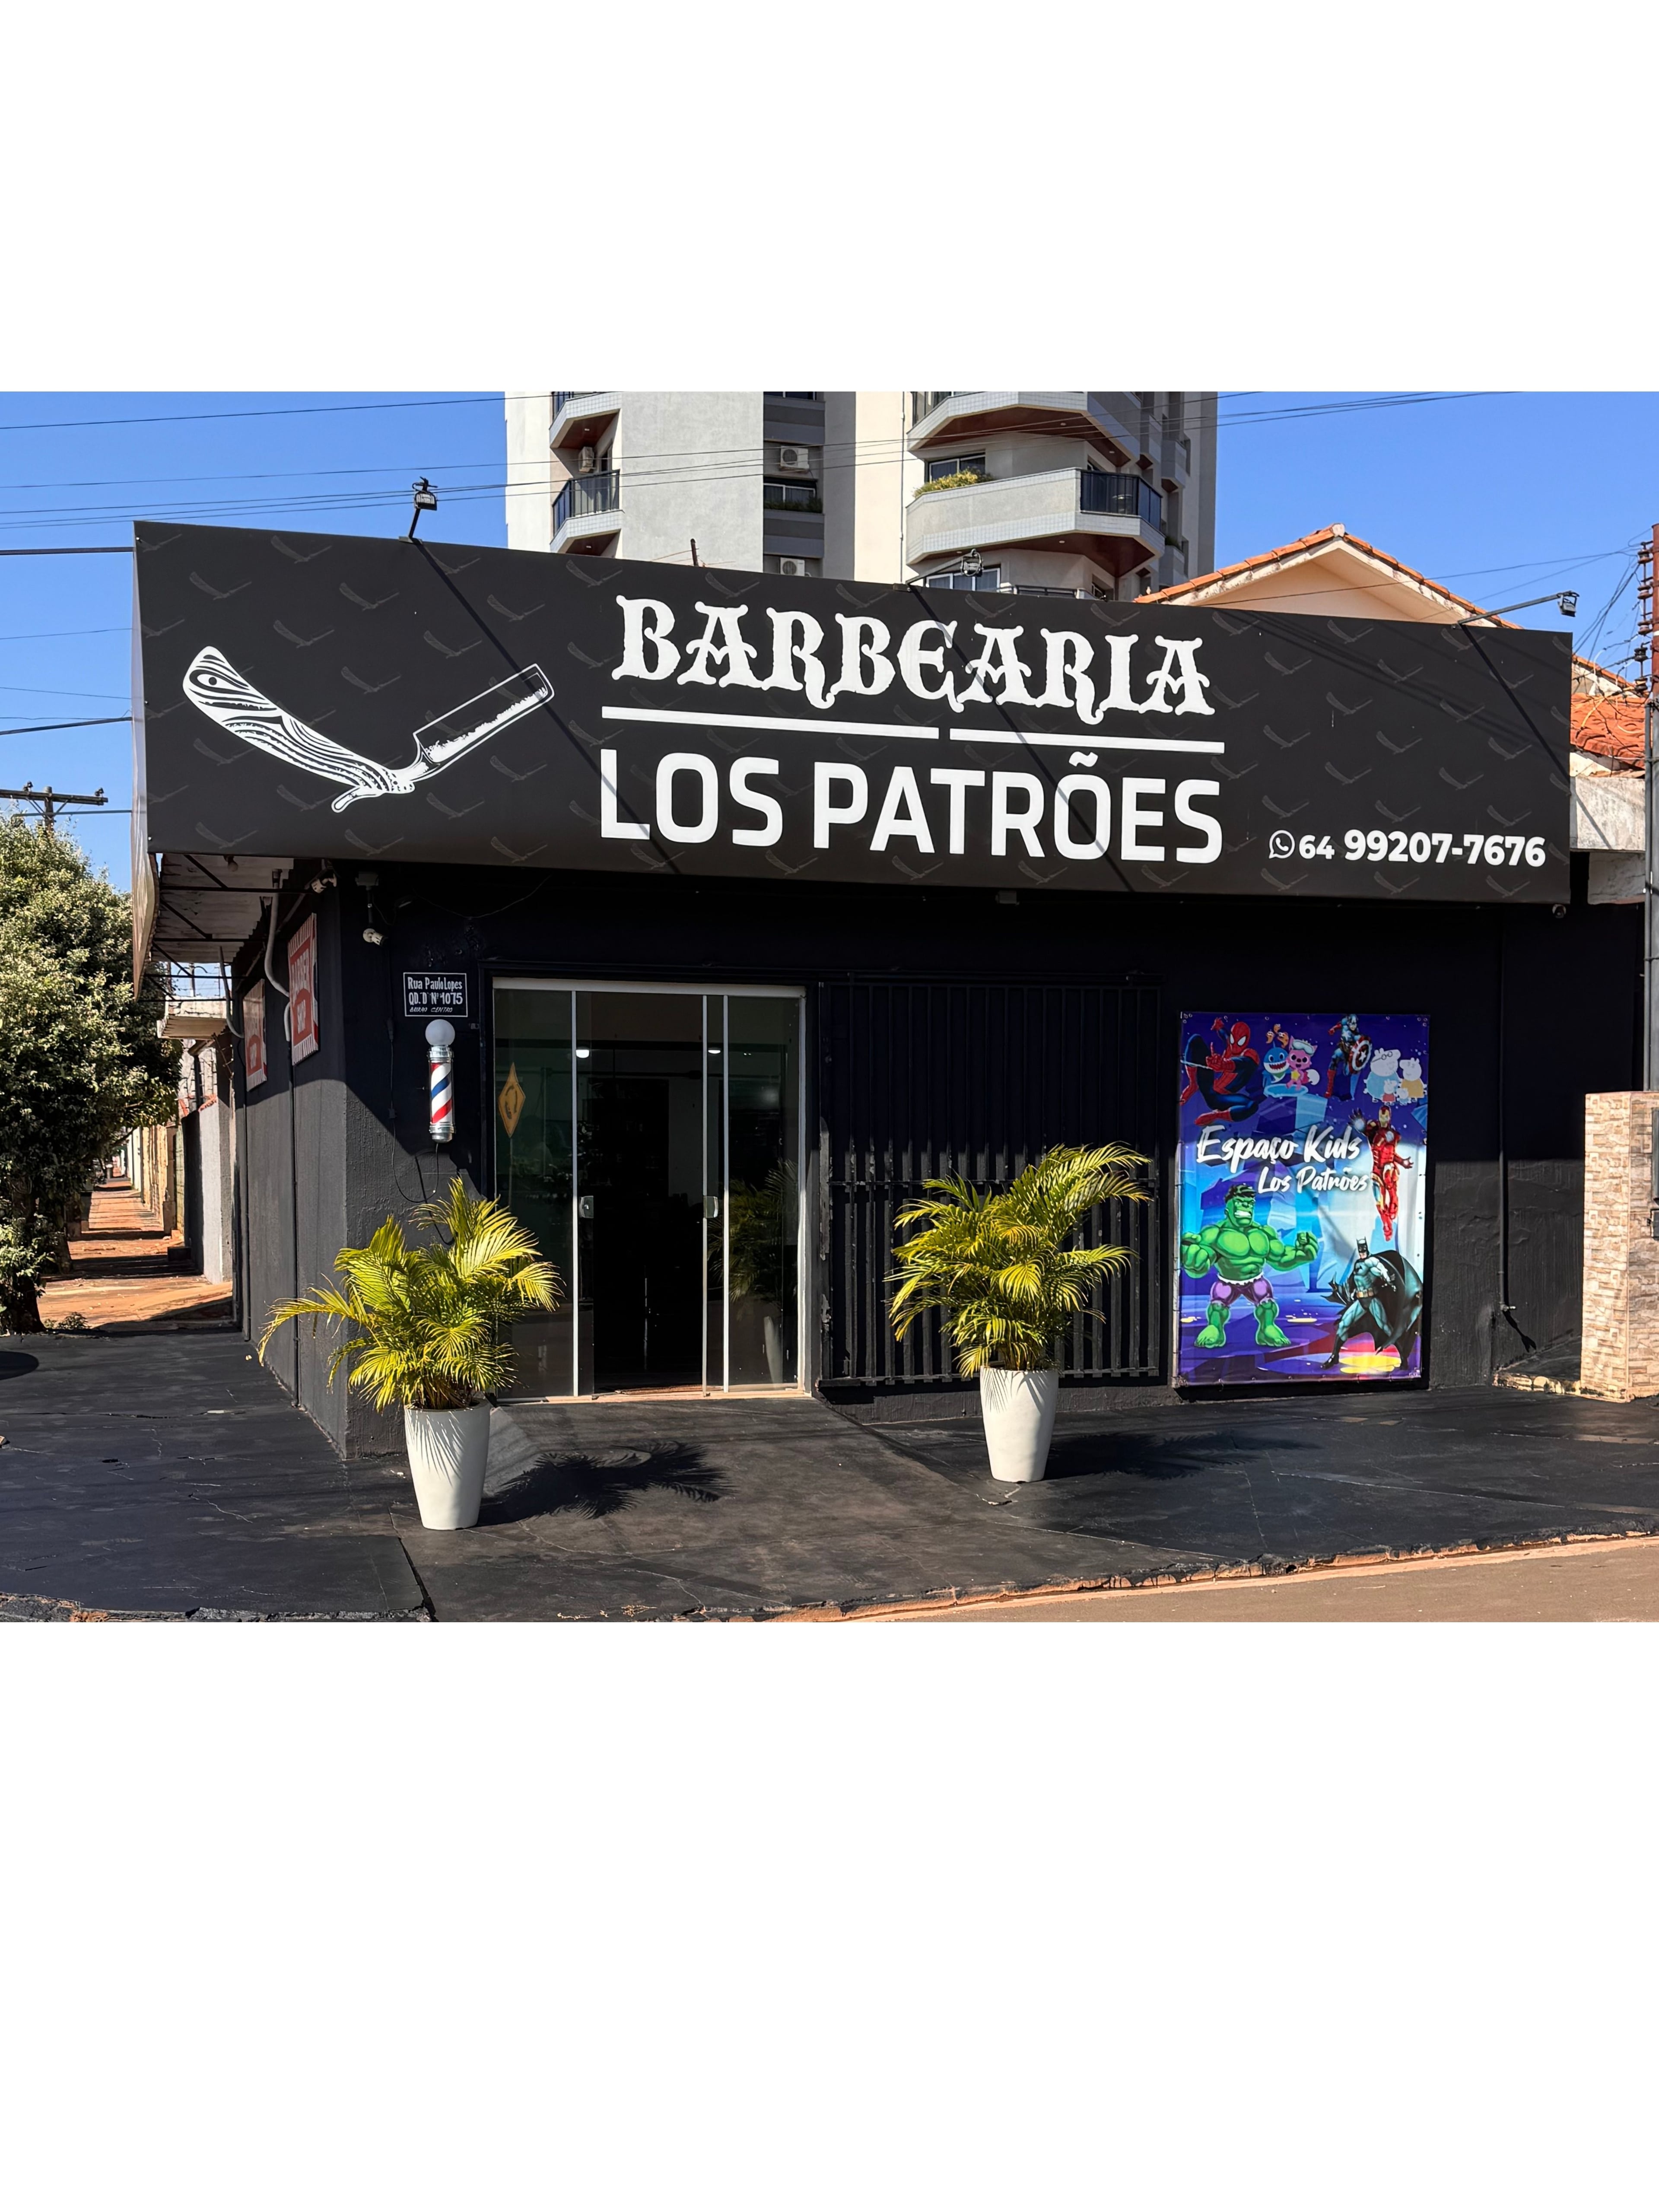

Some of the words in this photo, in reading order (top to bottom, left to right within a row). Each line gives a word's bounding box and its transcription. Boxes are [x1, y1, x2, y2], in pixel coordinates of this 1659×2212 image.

[611, 595, 1215, 725] BARBEARIA
[601, 749, 783, 847] LOS
[814, 752, 1223, 864] PATRÕES
[1299, 834, 1335, 859] 64
[1344, 829, 1546, 867] 99207-7676
[407, 976, 423, 989] Rua
[425, 977, 443, 990] Paulo
[444, 977, 463, 992] Lopes
[408, 992, 421, 1005] QD.
[440, 992, 463, 1004] 1075
[1196, 1125, 1299, 1174] Espaço
[1303, 1124, 1362, 1163] Kids
[1258, 1166, 1292, 1194] Los
[1296, 1166, 1370, 1194] Patrões
